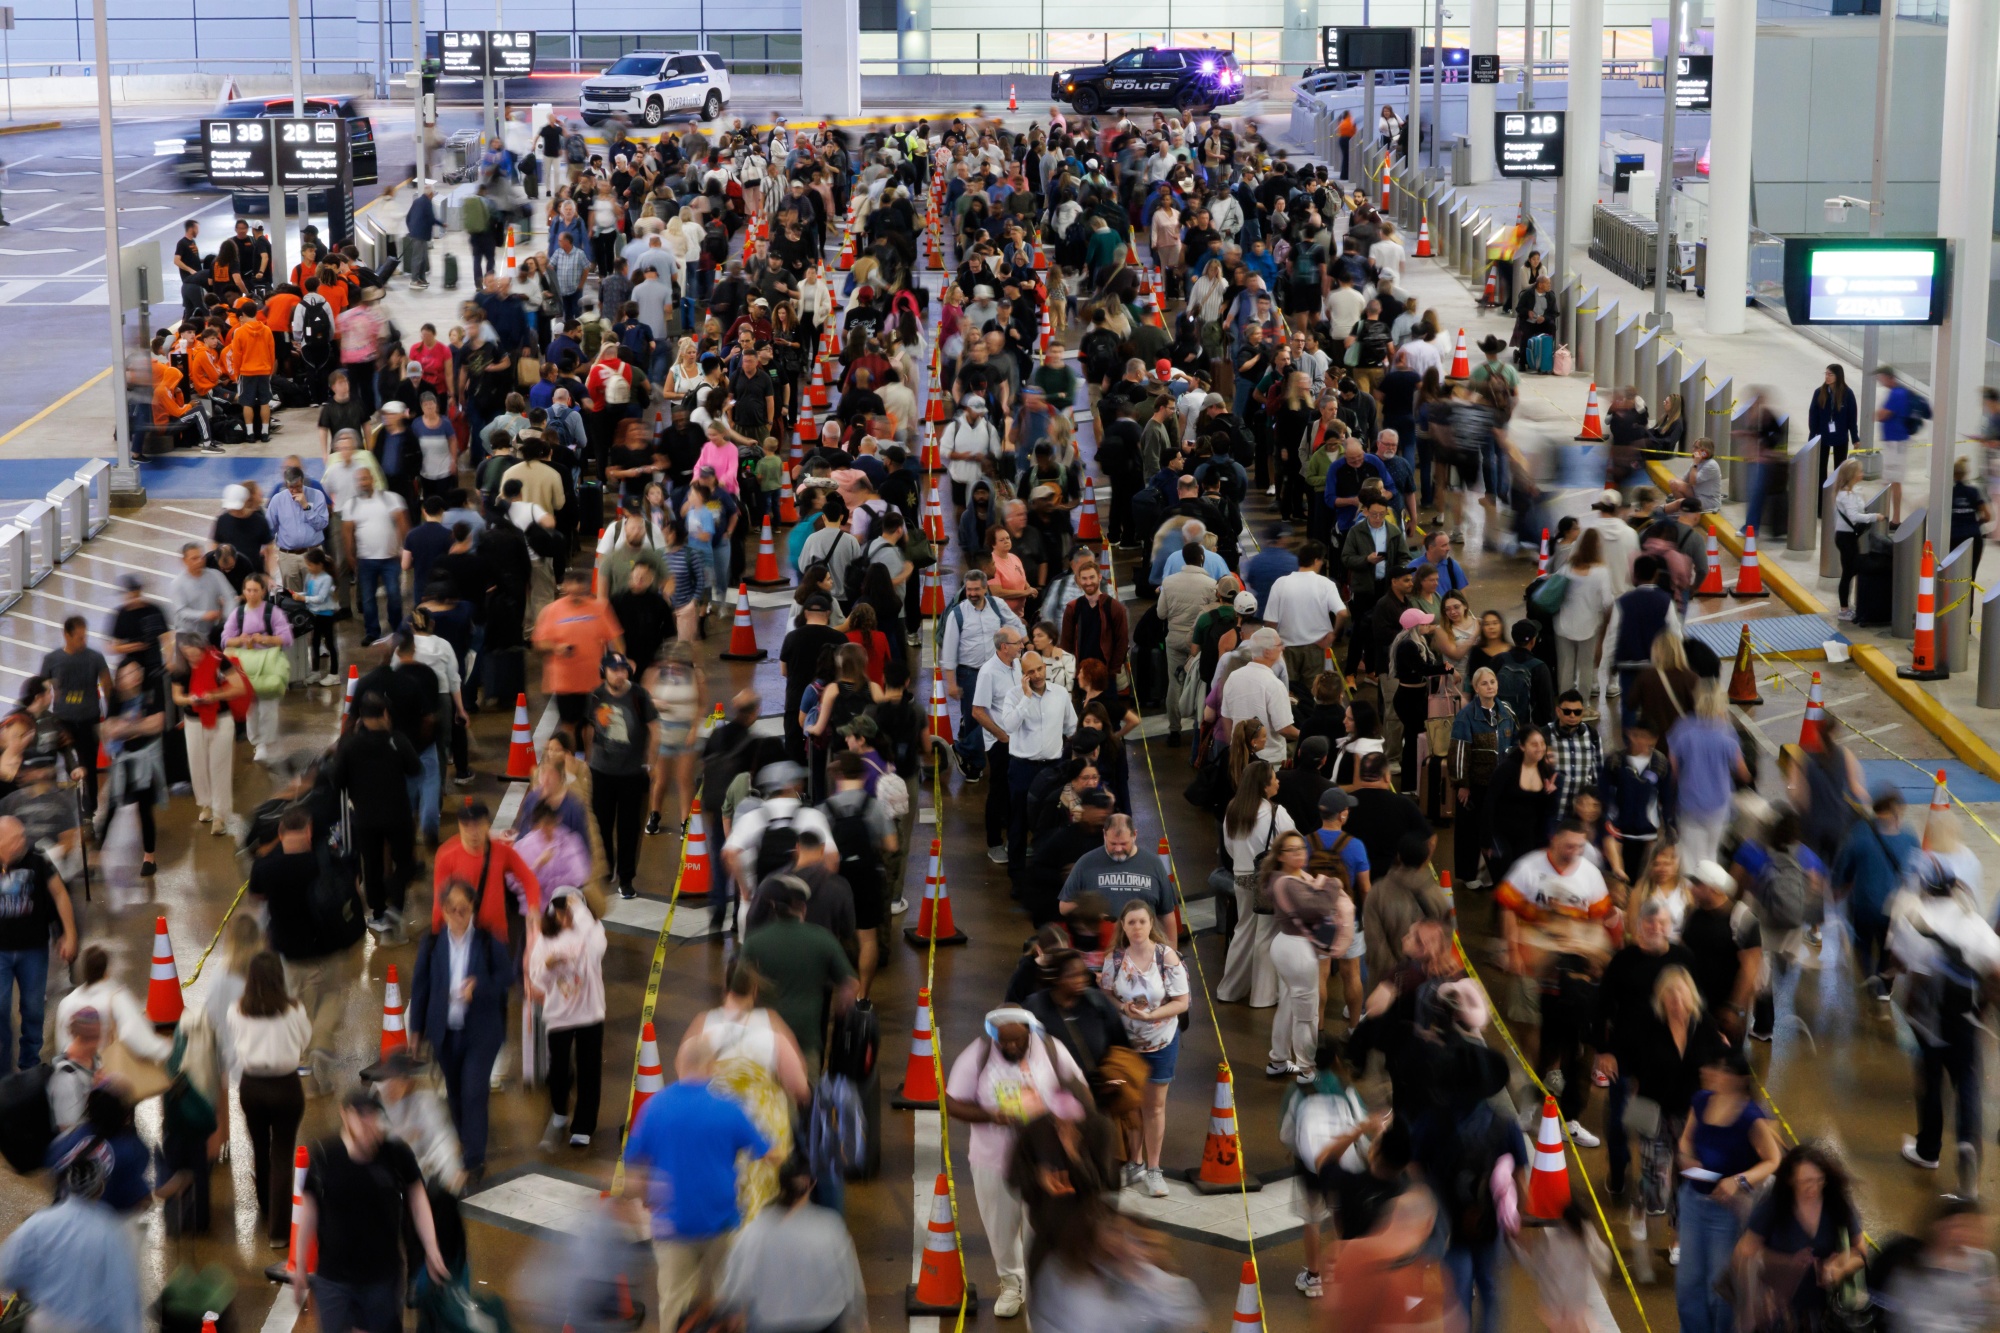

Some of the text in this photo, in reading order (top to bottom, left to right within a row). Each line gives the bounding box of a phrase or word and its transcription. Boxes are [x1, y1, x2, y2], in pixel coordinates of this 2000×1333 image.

[461, 33, 481, 46] 3A
[493, 33, 513, 46] 2A
[1530, 116, 1557, 134] 1B
[236, 123, 263, 142] 3B
[283, 123, 310, 142] 2B
[684, 862, 701, 871] PPM
[1098, 874, 1152, 888] DADALORIAN
